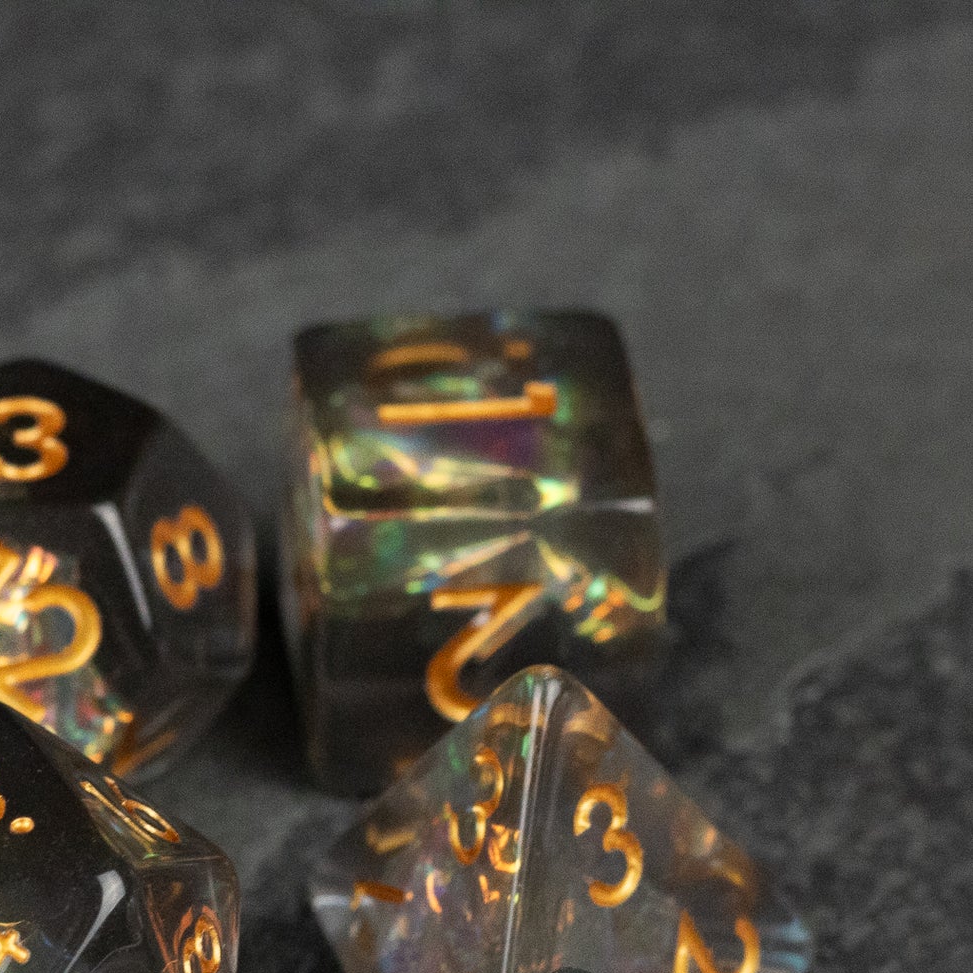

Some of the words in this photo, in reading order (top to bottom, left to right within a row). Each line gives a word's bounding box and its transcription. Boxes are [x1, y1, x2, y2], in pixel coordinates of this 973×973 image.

[150, 505, 223, 610] 8
[426, 583, 544, 723] 2
[574, 784, 643, 906] 3
